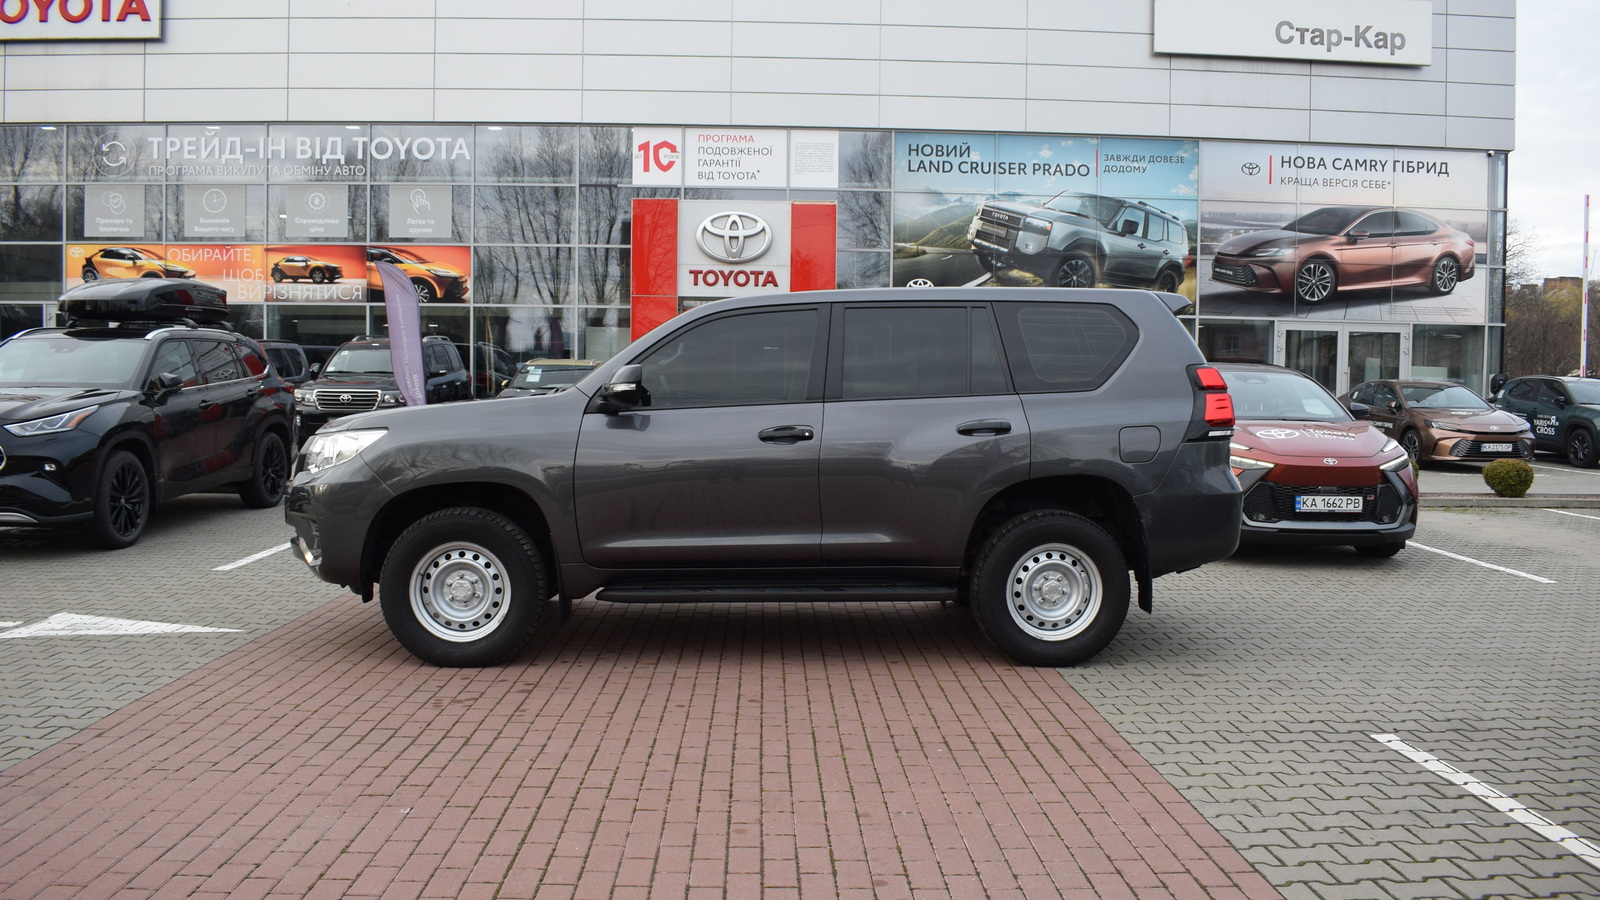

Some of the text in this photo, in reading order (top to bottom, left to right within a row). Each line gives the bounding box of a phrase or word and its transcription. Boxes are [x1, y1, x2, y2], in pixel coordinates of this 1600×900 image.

[1275, 20, 1406, 56] Стар-Кар
[697, 134, 755, 144] ПРОГРАМА
[148, 130, 471, 163] ТРЕЙД-ІН ВІД TOYOTA
[697, 145, 773, 157] ПОДОВЖЕНОЇ
[907, 141, 971, 158] НОВИЙ
[697, 158, 741, 168] ГАРАНТІЇ
[1103, 153, 1185, 165] ЗАВЖДИ ДОВЕЗЕ
[148, 165, 365, 177] ПРОГРАМА ВИКУПУ ТА ОБМІНУ АВТО
[907, 159, 1090, 177] LAND CRUISER PRADO
[1103, 164, 1148, 175] ДОДОМУ
[1280, 155, 1450, 178] НОВА CAMRY ГІБРИД
[697, 170, 715, 181] ВІД
[1280, 176, 1320, 188] КРАЩА
[1321, 178, 1359, 189] ВЕРСІЯ
[167, 246, 256, 264] ОБИРАЙТЕ,
[223, 268, 264, 283] ЩОБ
[689, 269, 779, 288] TOYOTA
[237, 284, 362, 300] ВИРІЗНЯТИСЯ
[1536, 426, 1555, 435] CROSS
[1302, 497, 1318, 508] KA
[1321, 497, 1344, 508] 1662
